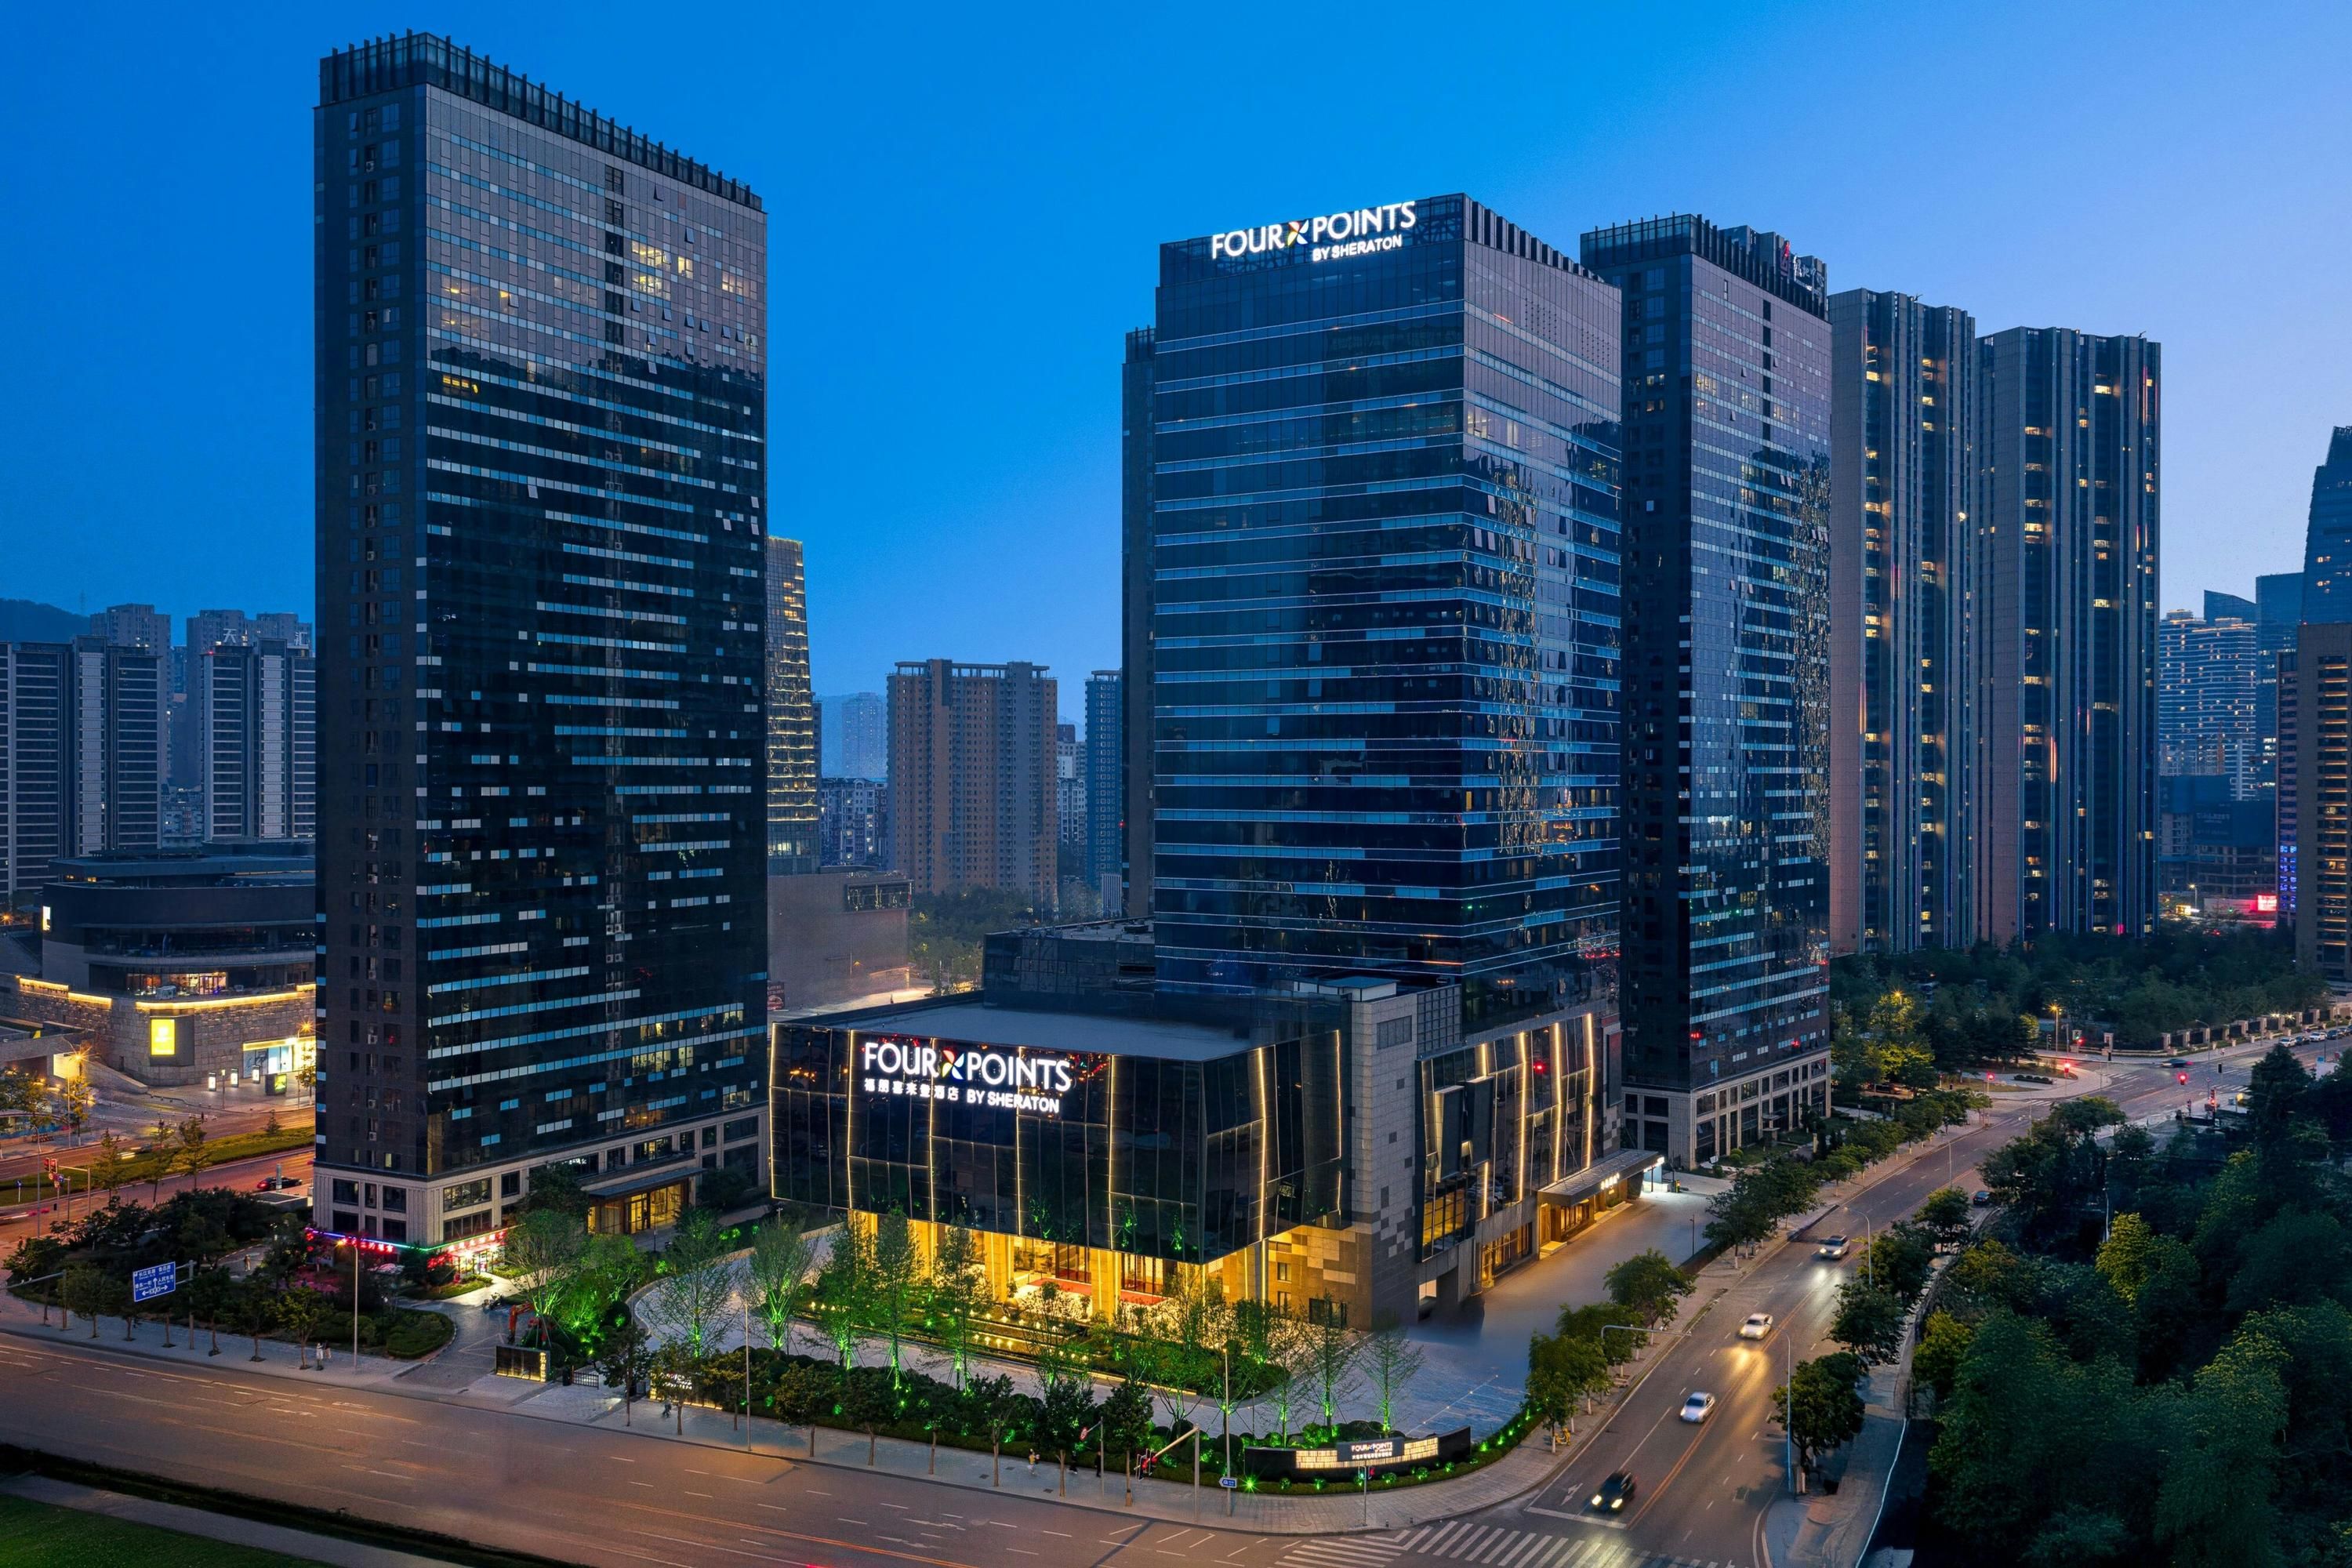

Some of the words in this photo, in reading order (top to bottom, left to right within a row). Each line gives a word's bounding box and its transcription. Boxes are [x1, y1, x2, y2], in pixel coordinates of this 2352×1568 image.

[1211, 223, 1285, 260] FOUR
[1312, 201, 1417, 242] POINTS
[1312, 246, 1331, 261] BY
[1332, 234, 1403, 258] SHERATON
[223, 628, 237, 644] 天
[865, 1042, 939, 1078] FOUR
[967, 1051, 1072, 1092] POINTS
[966, 1088, 985, 1104] BY
[986, 1091, 1060, 1113] SHERATON
